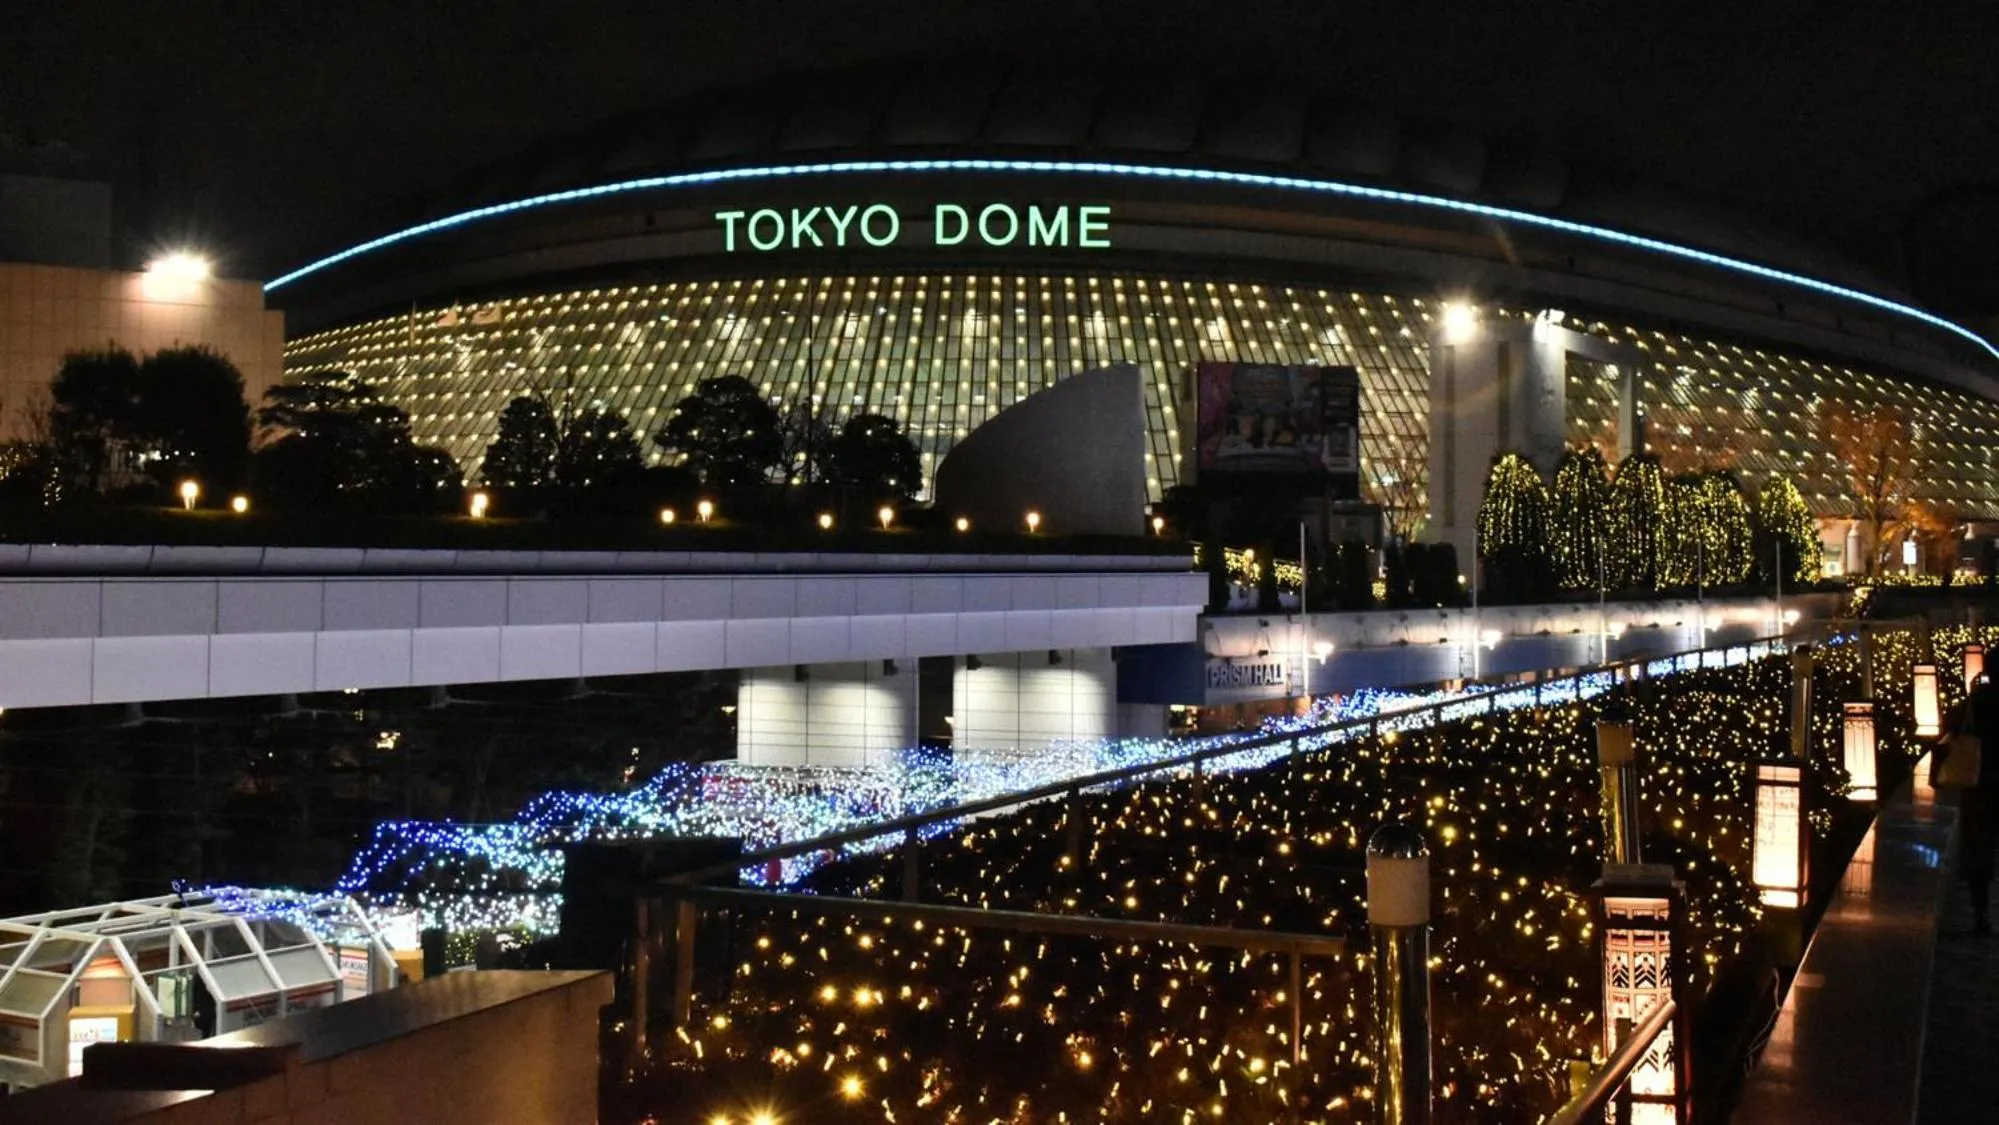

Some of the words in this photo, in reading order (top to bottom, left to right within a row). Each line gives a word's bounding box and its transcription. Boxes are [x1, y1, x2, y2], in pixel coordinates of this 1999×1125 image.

[715, 205, 899, 252] TOKYO
[935, 204, 1111, 248] DOME
[1208, 665, 1253, 688] PRISM
[1254, 664, 1285, 686] HALL
